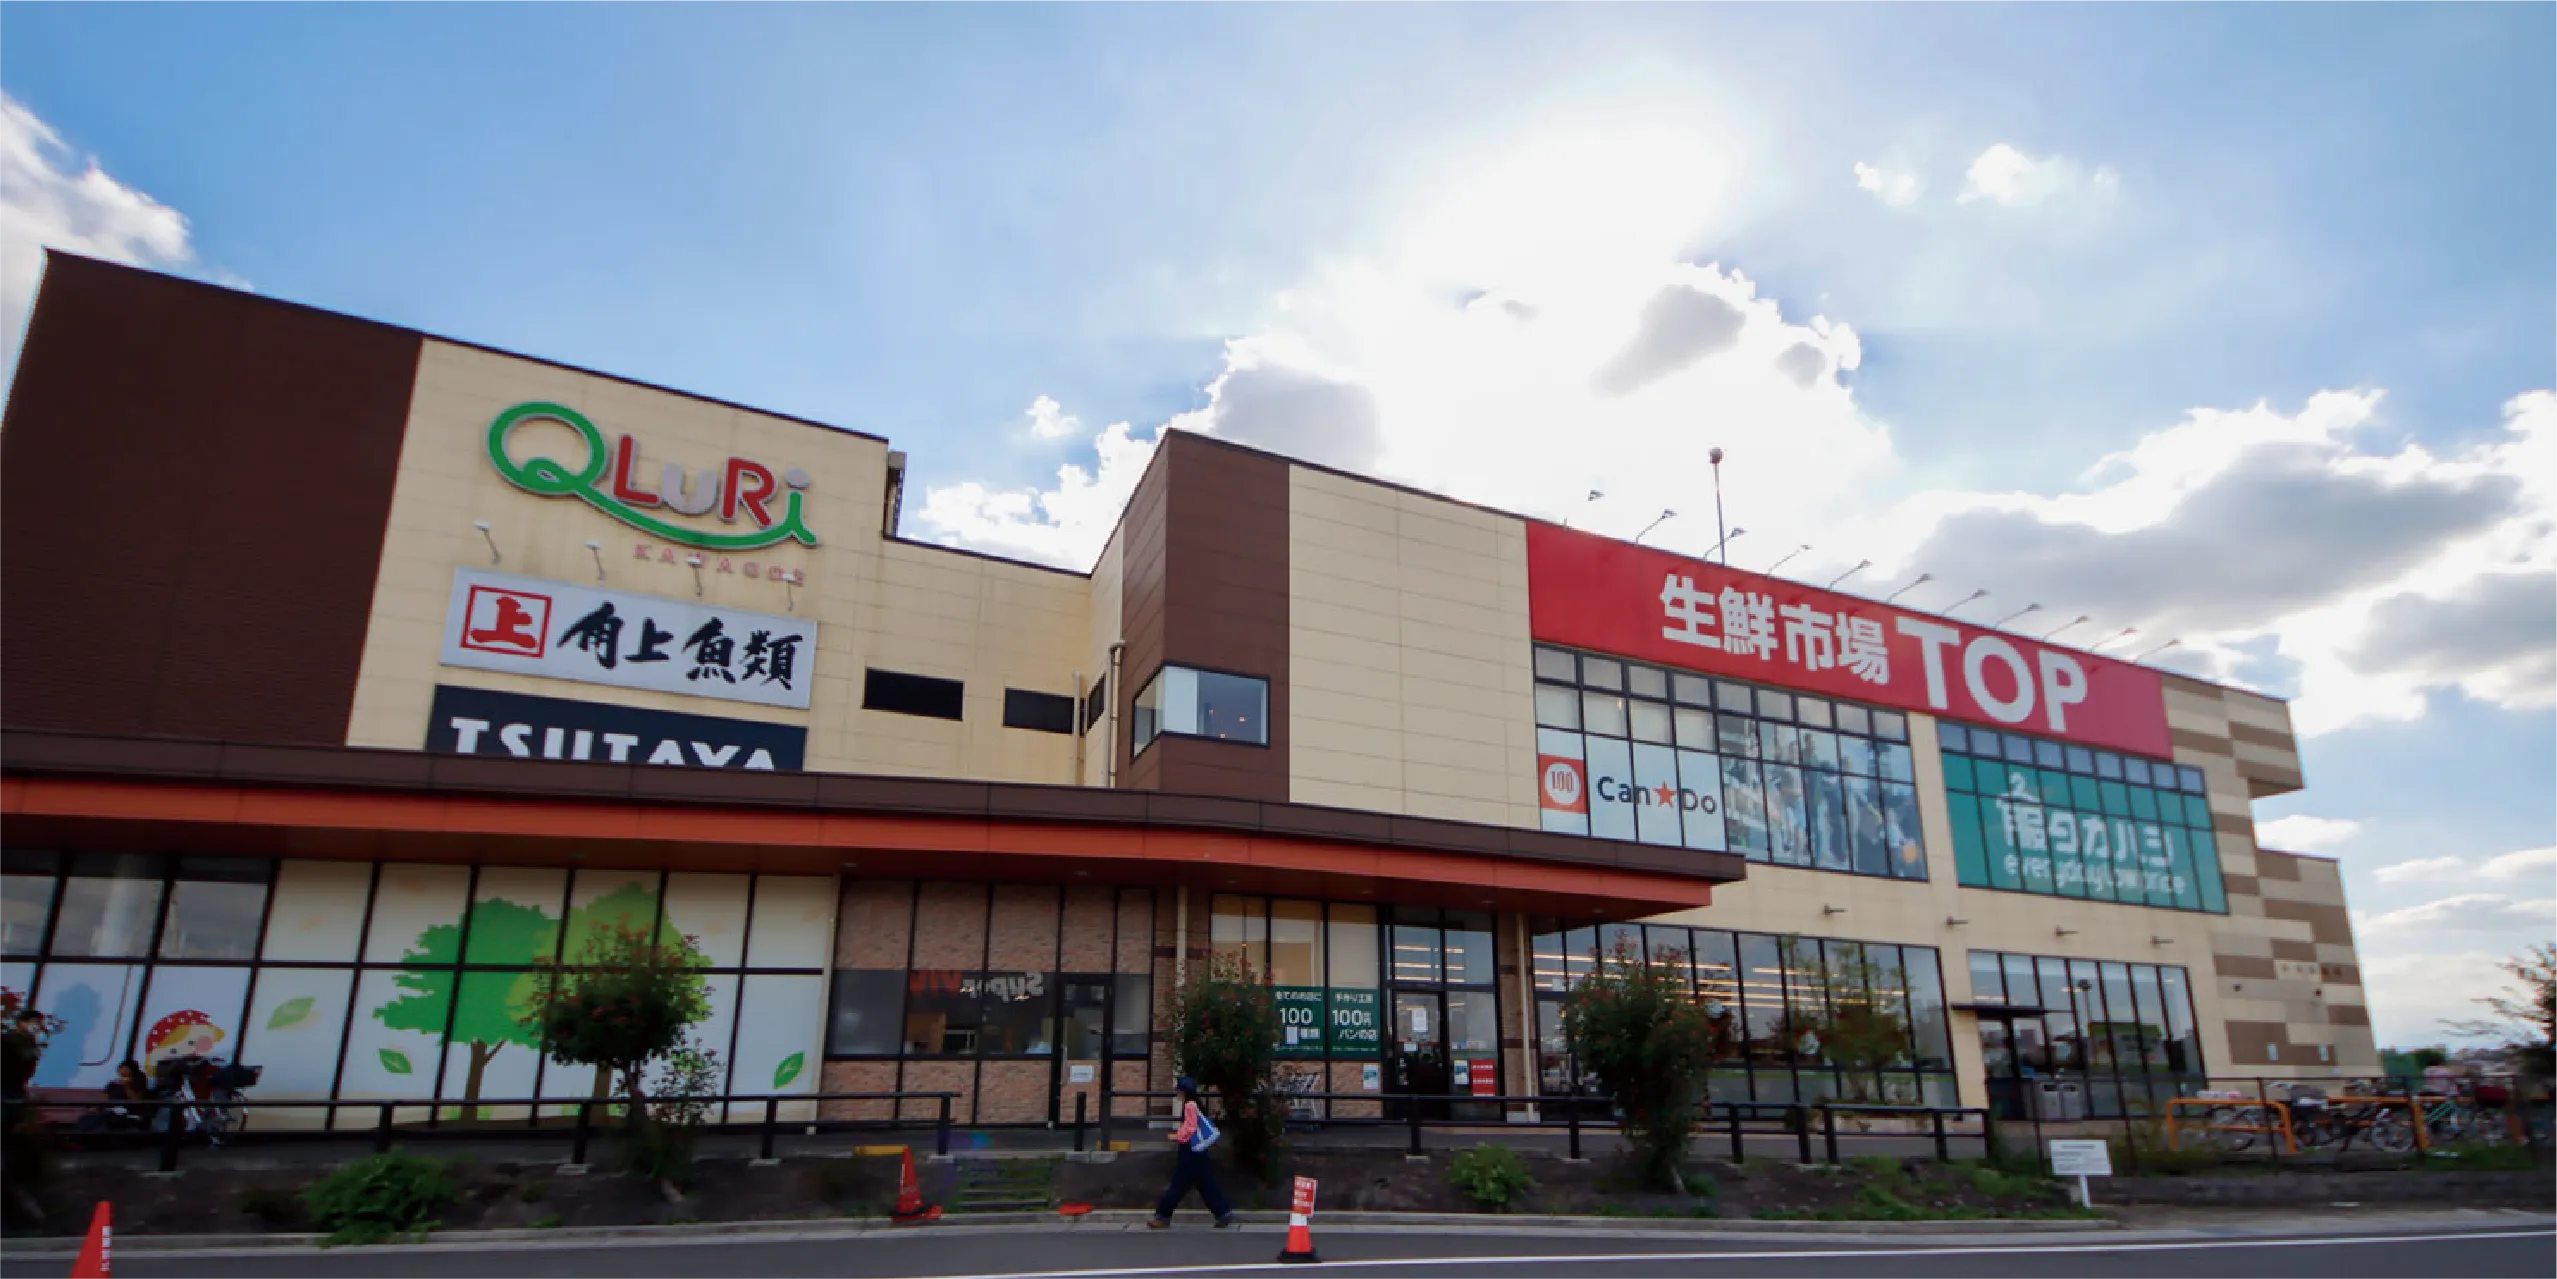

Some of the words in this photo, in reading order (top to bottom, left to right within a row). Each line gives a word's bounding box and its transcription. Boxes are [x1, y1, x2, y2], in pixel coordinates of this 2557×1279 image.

[557, 602, 803, 690] 角上魚類
[1660, 573, 1891, 686] 生鮮市場
[1897, 616, 2088, 733] TOP
[1280, 1008, 1314, 1024] 100
